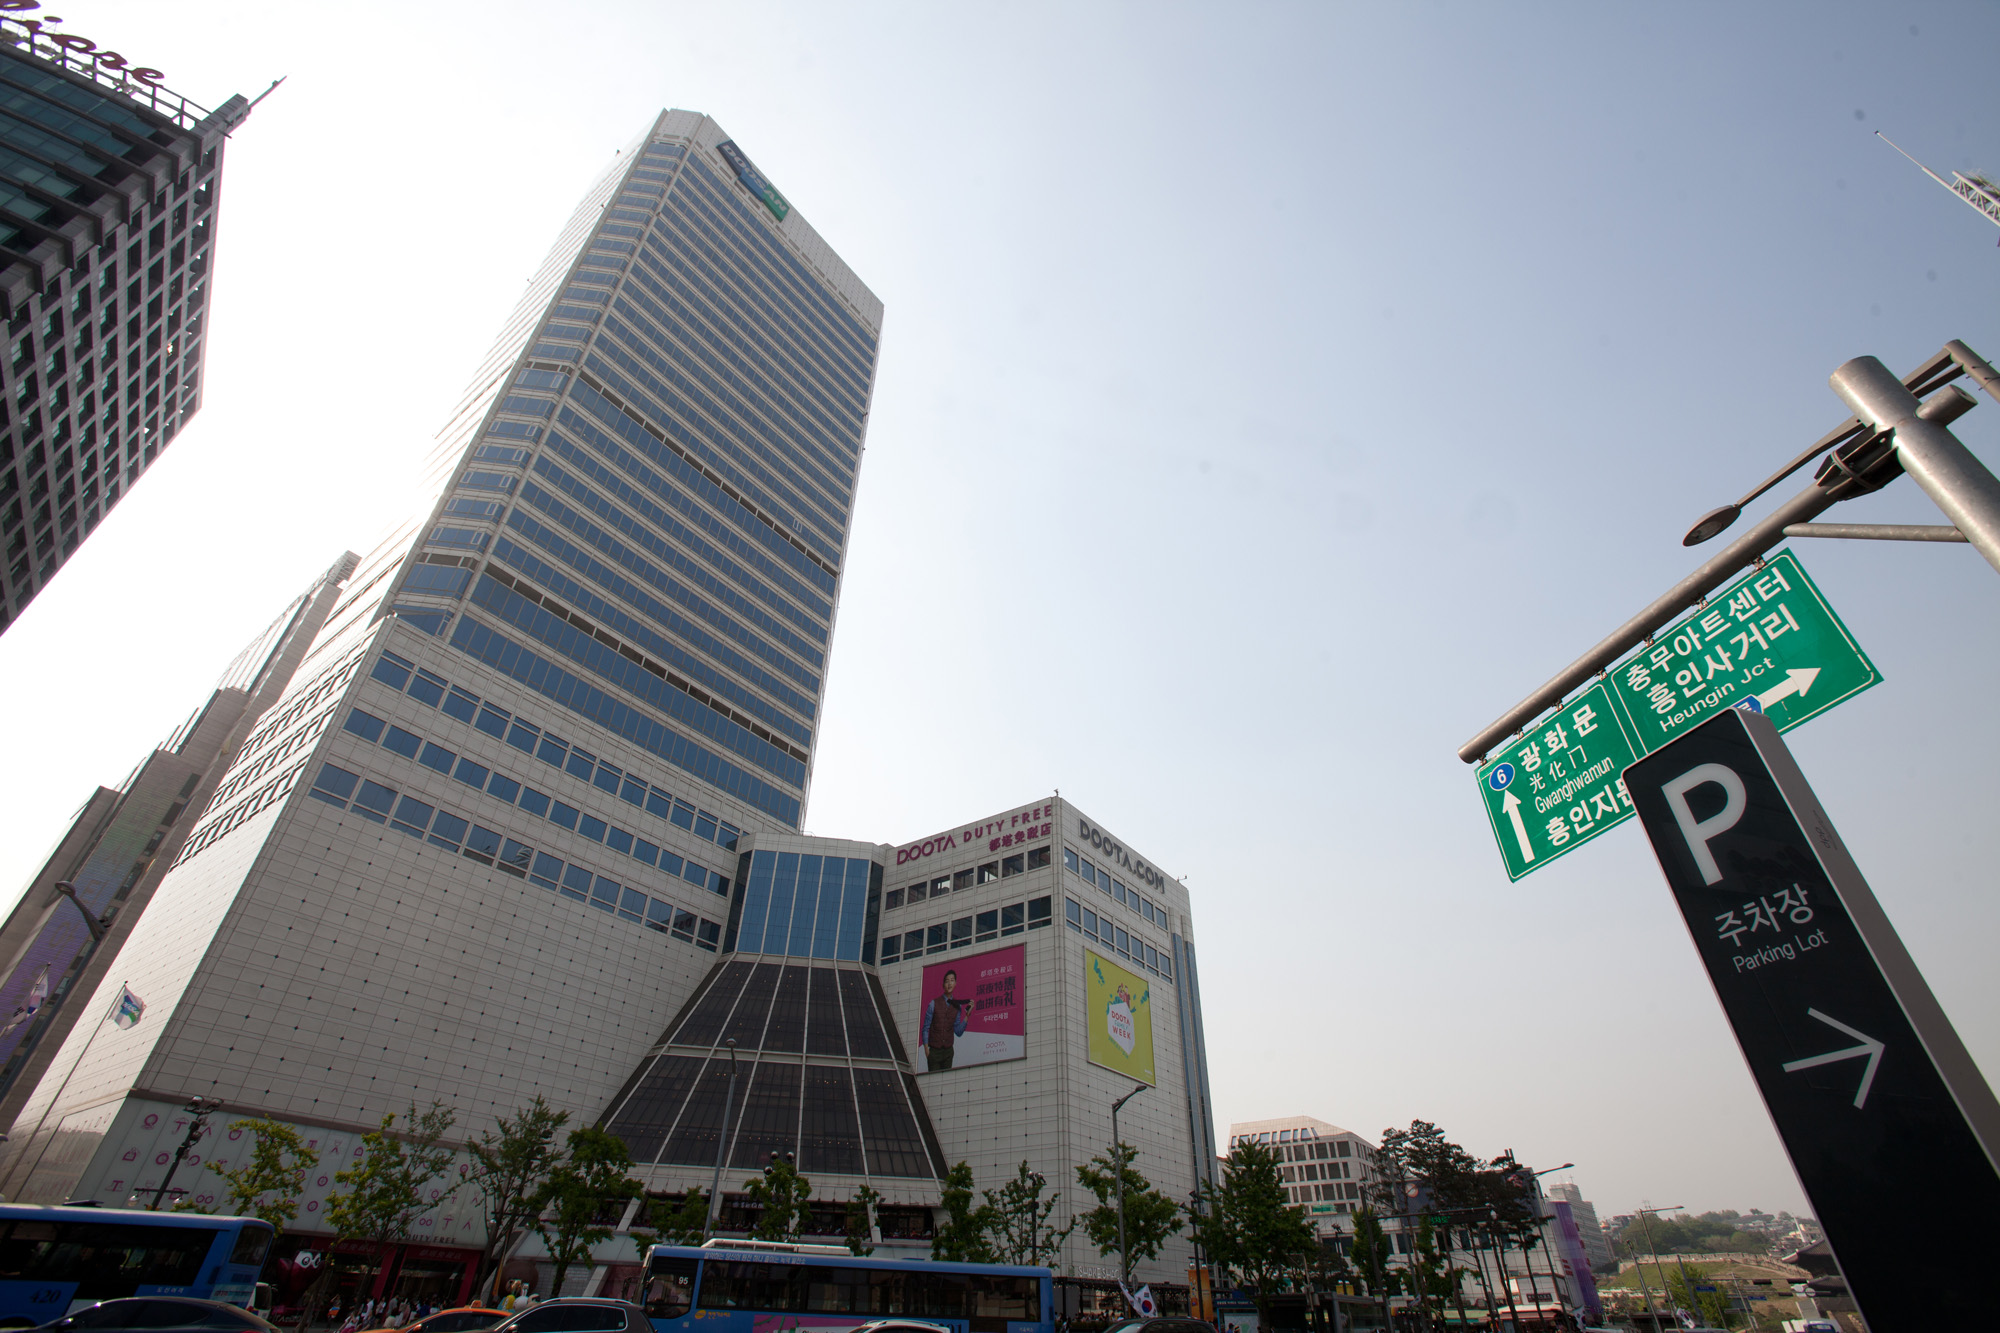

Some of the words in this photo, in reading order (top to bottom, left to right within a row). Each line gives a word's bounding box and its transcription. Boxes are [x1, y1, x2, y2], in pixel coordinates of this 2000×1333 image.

[721, 144, 788, 213] DOOSAN
[1626, 566, 1791, 692] 충무아트센터
[1646, 603, 1800, 715] 흥인사거리
[1659, 682, 1735, 732] Heungin
[1740, 657, 1775, 684] Jct
[1496, 768, 1507, 785] 6
[1534, 757, 1615, 813] Gwanghwamun
[897, 834, 956, 865] DOOTA
[963, 820, 1005, 842] DUTY
[1011, 804, 1052, 827] FREE
[1661, 763, 1747, 886] P
[1079, 817, 1165, 894] DOOTA.COM
[1715, 883, 1813, 947] 주차장
[1732, 942, 1796, 973] Parking
[1795, 928, 1829, 952] Lot
[1111, 1010, 1131, 1026] DOOTA
[1112, 1025, 1132, 1040] WEEK
[433, 1236, 457, 1244] FREE
[30, 1289, 62, 1303] 420
[678, 1276, 689, 1285] 95
